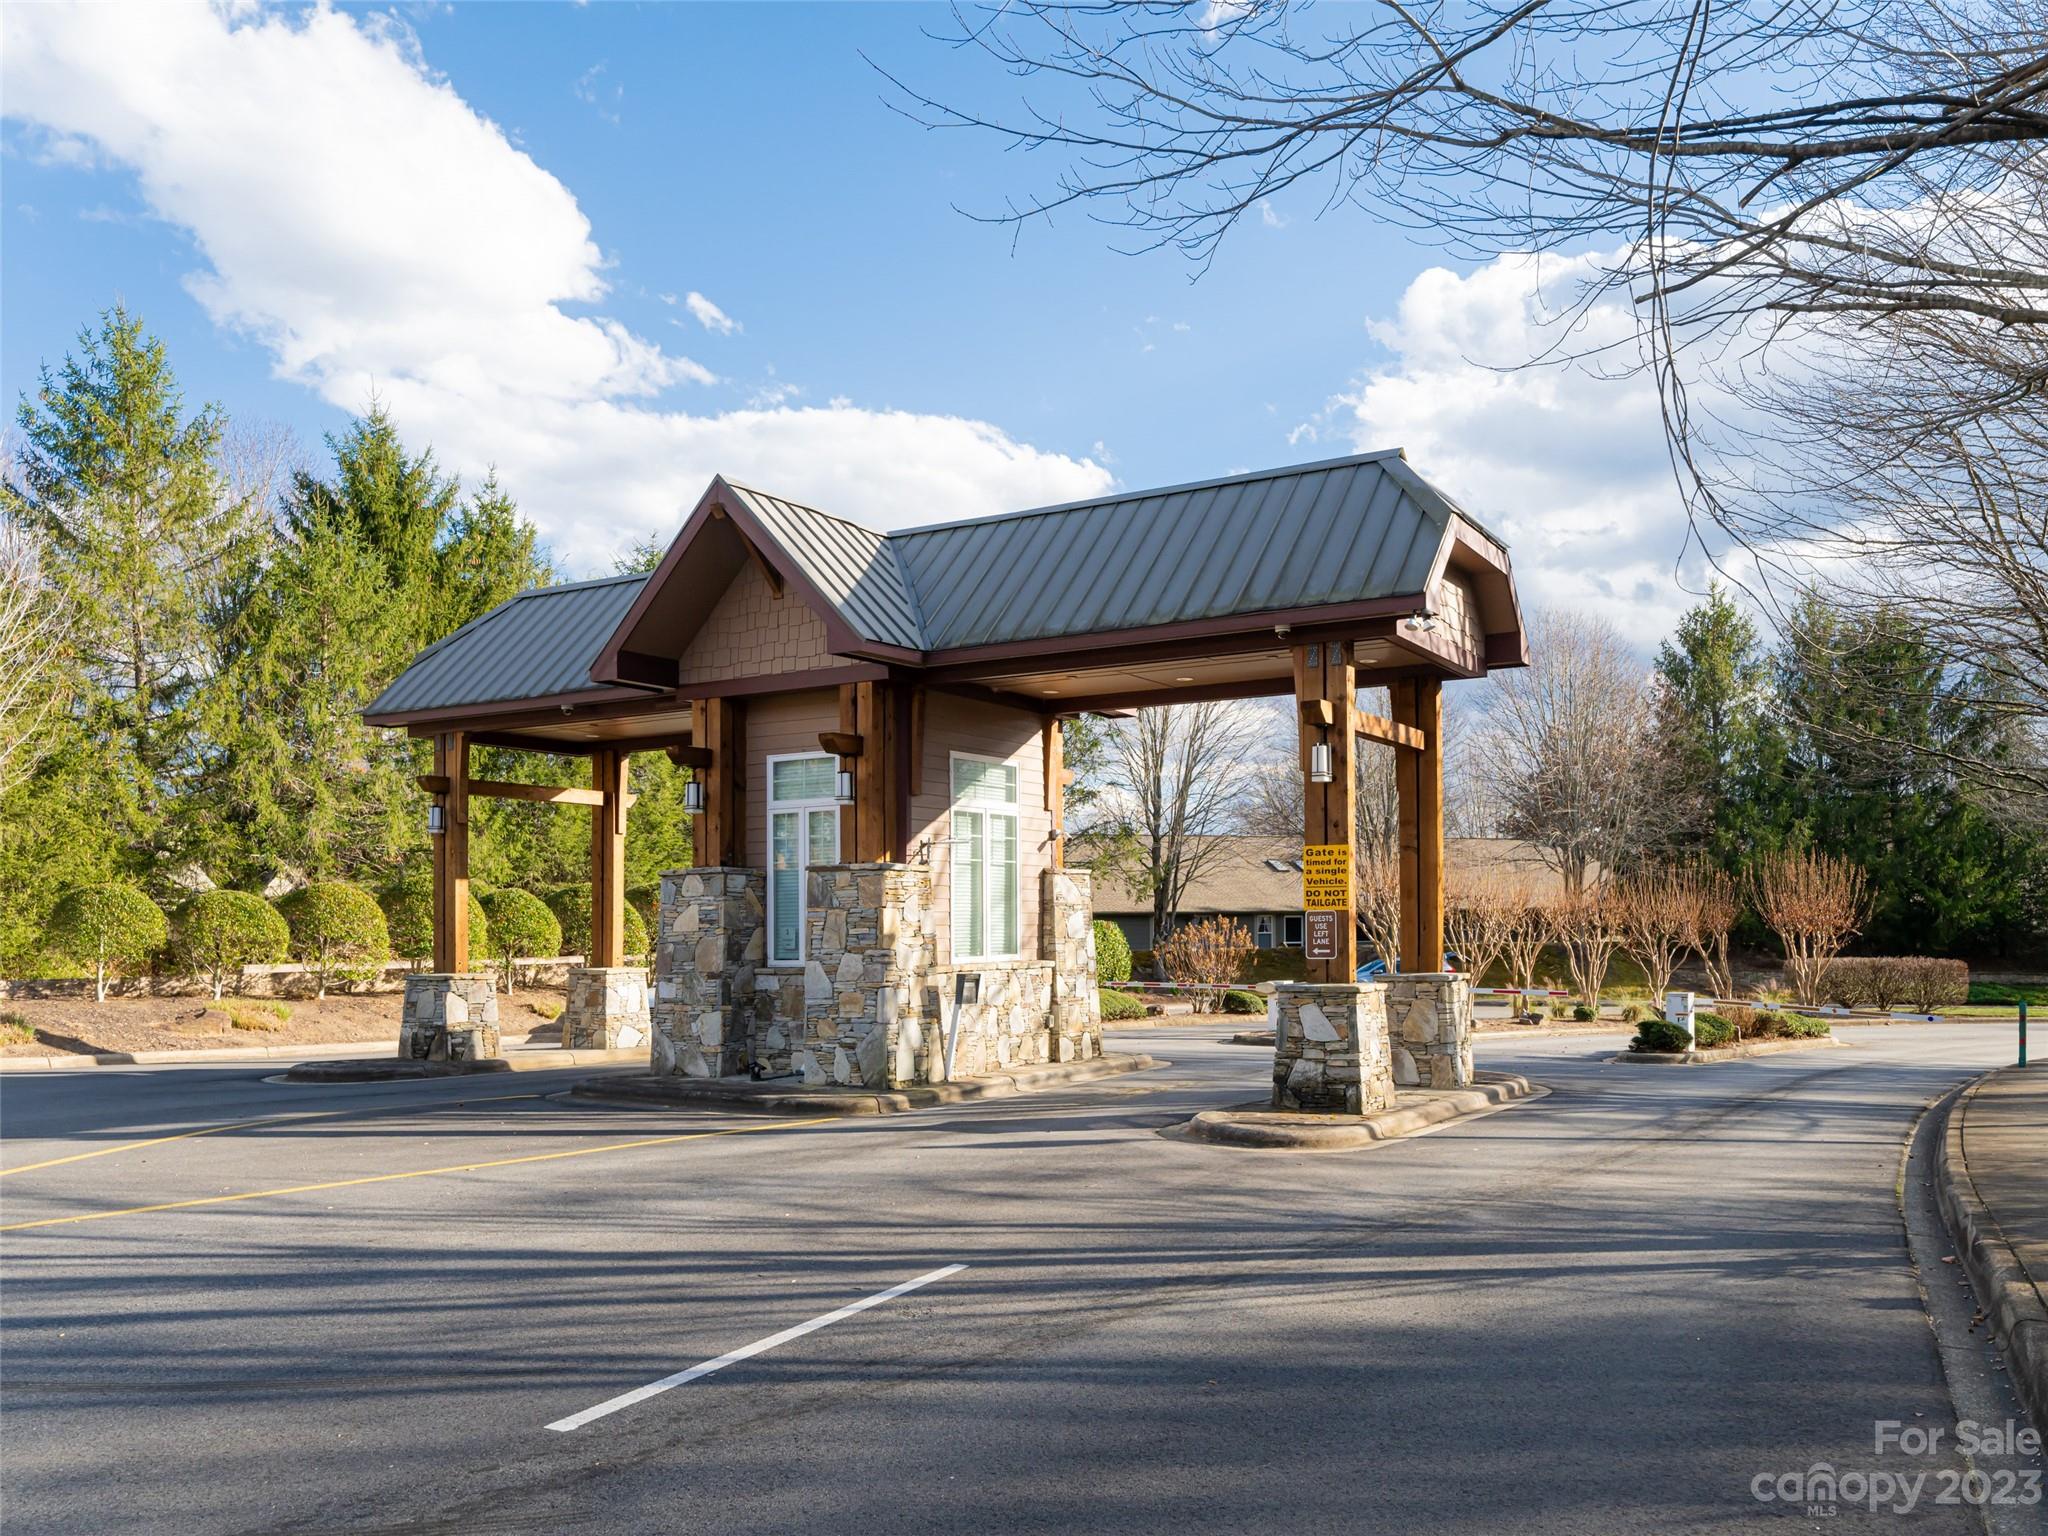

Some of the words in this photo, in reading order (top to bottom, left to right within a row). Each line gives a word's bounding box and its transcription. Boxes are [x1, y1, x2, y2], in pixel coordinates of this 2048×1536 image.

[1306, 849, 1334, 857] Gate
[1315, 868, 1347, 876] single
[1306, 899, 1347, 907] TAILGATE
